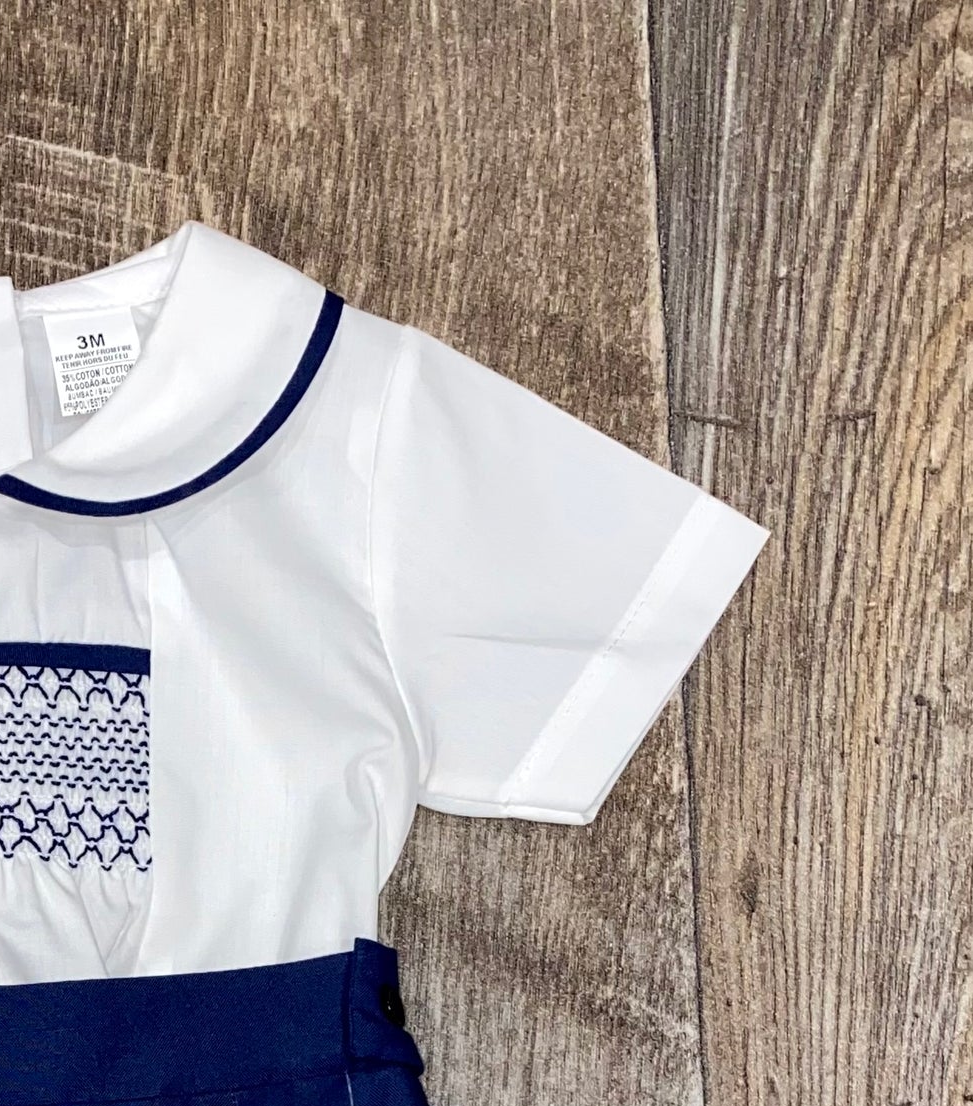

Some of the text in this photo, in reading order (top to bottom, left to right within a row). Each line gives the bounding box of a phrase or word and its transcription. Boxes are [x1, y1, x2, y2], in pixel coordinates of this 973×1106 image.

[76, 333, 105, 349] 3M
[55, 354, 73, 362] KEEP
[75, 351, 95, 359] AWAY
[96, 347, 117, 355] FROM
[62, 360, 81, 369] TENIR
[83, 357, 102, 366] HORS
